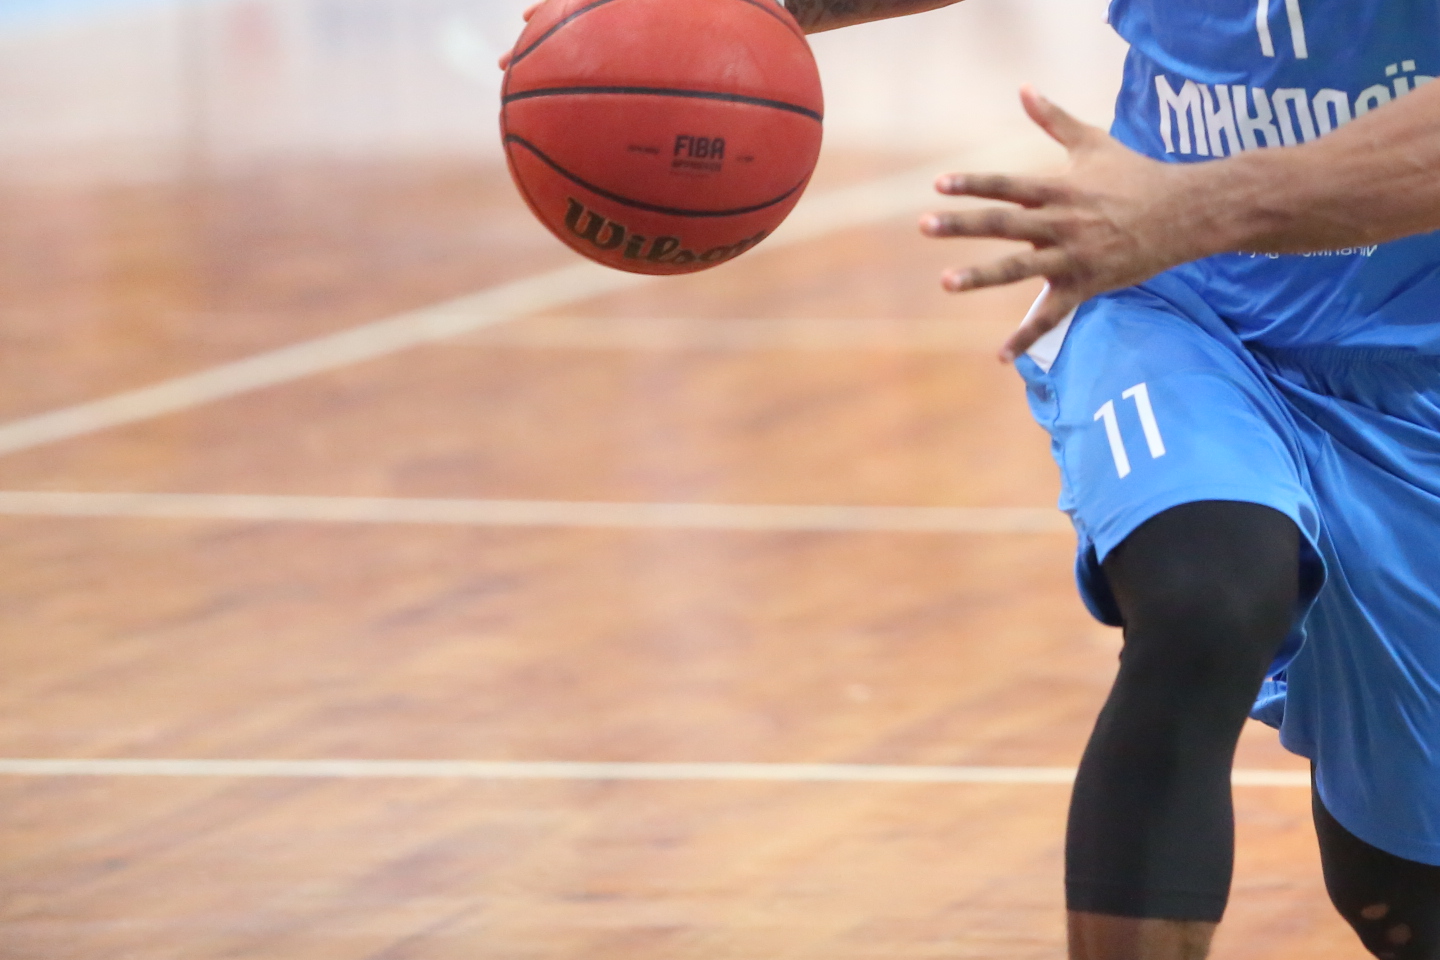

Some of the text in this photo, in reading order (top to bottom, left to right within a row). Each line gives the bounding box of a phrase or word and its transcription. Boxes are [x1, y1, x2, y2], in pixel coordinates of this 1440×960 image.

[674, 134, 726, 159] FIBA
[565, 197, 767, 264] Wilson
[1093, 382, 1166, 480] 11
